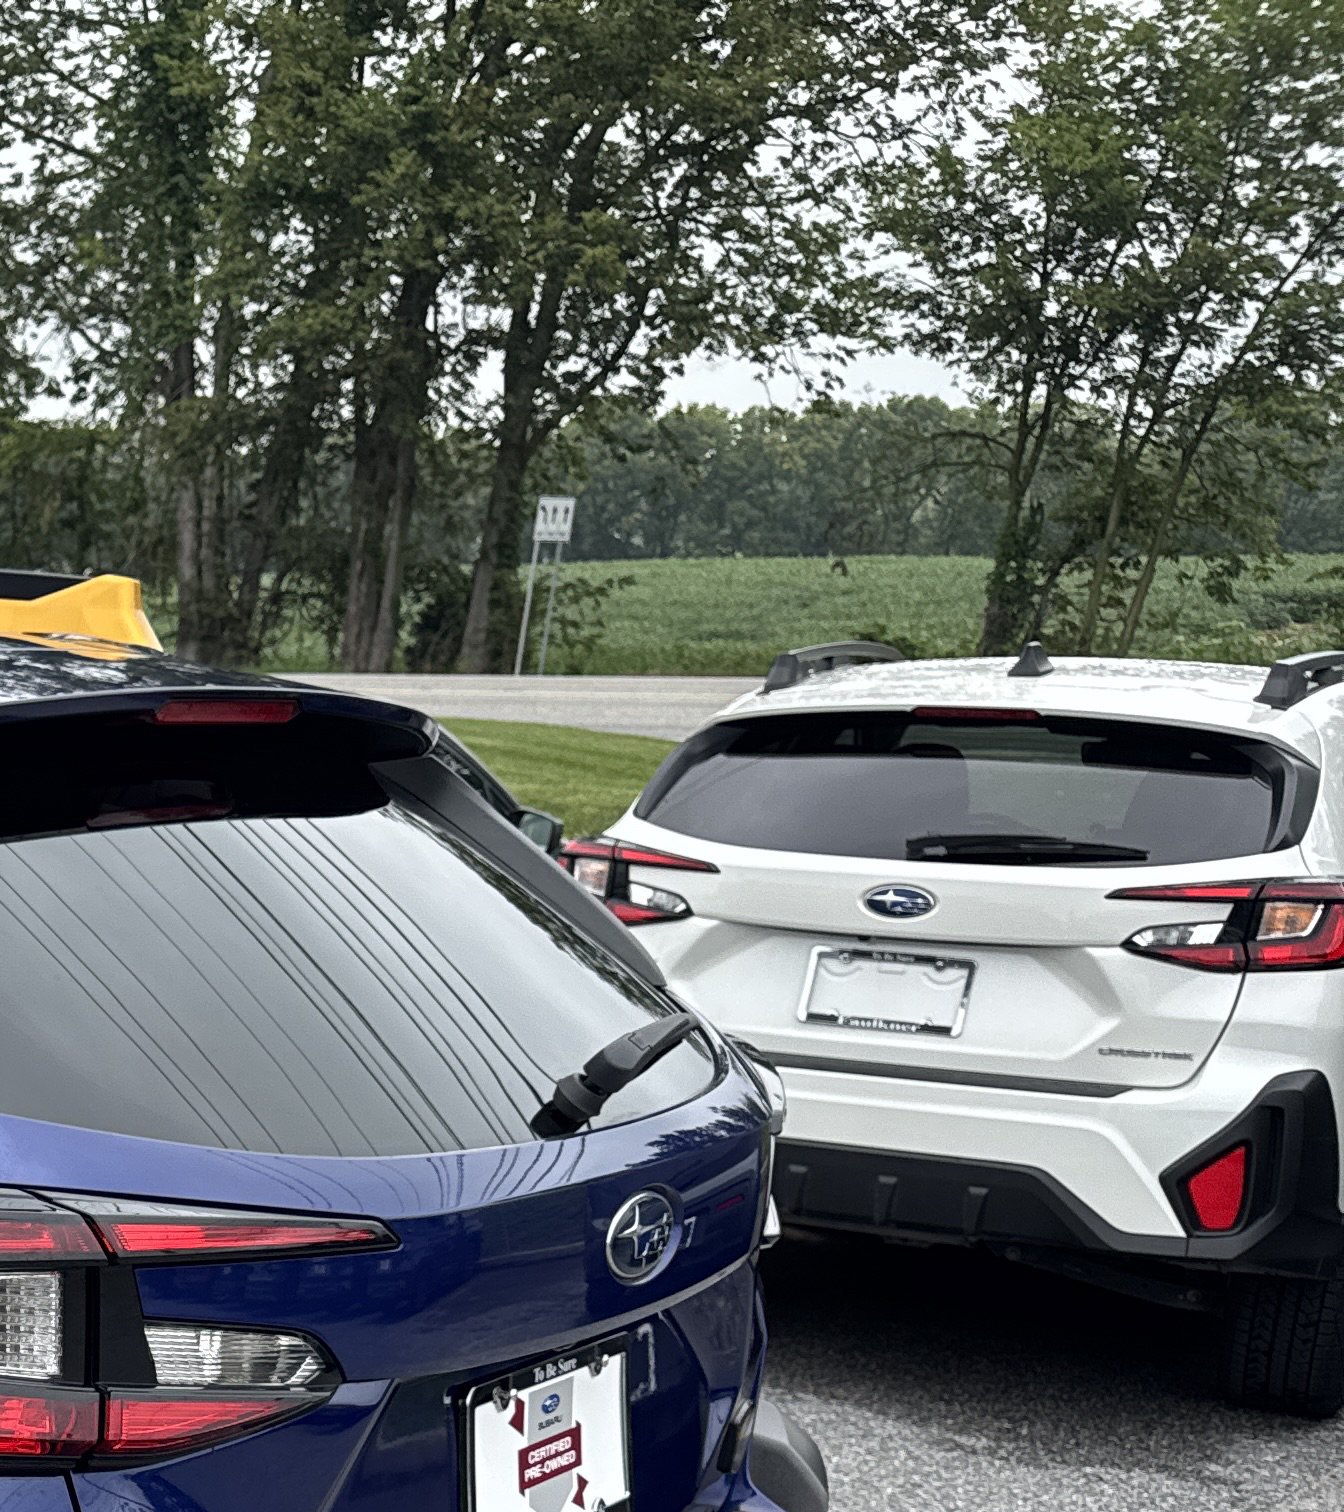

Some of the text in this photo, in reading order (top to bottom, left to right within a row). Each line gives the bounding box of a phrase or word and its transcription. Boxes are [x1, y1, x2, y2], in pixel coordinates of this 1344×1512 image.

[533, 1357, 579, 1384] To Be Sure
[528, 1436, 572, 1465] CERTIFIED
[524, 1450, 576, 1482] PRE-OWNED
